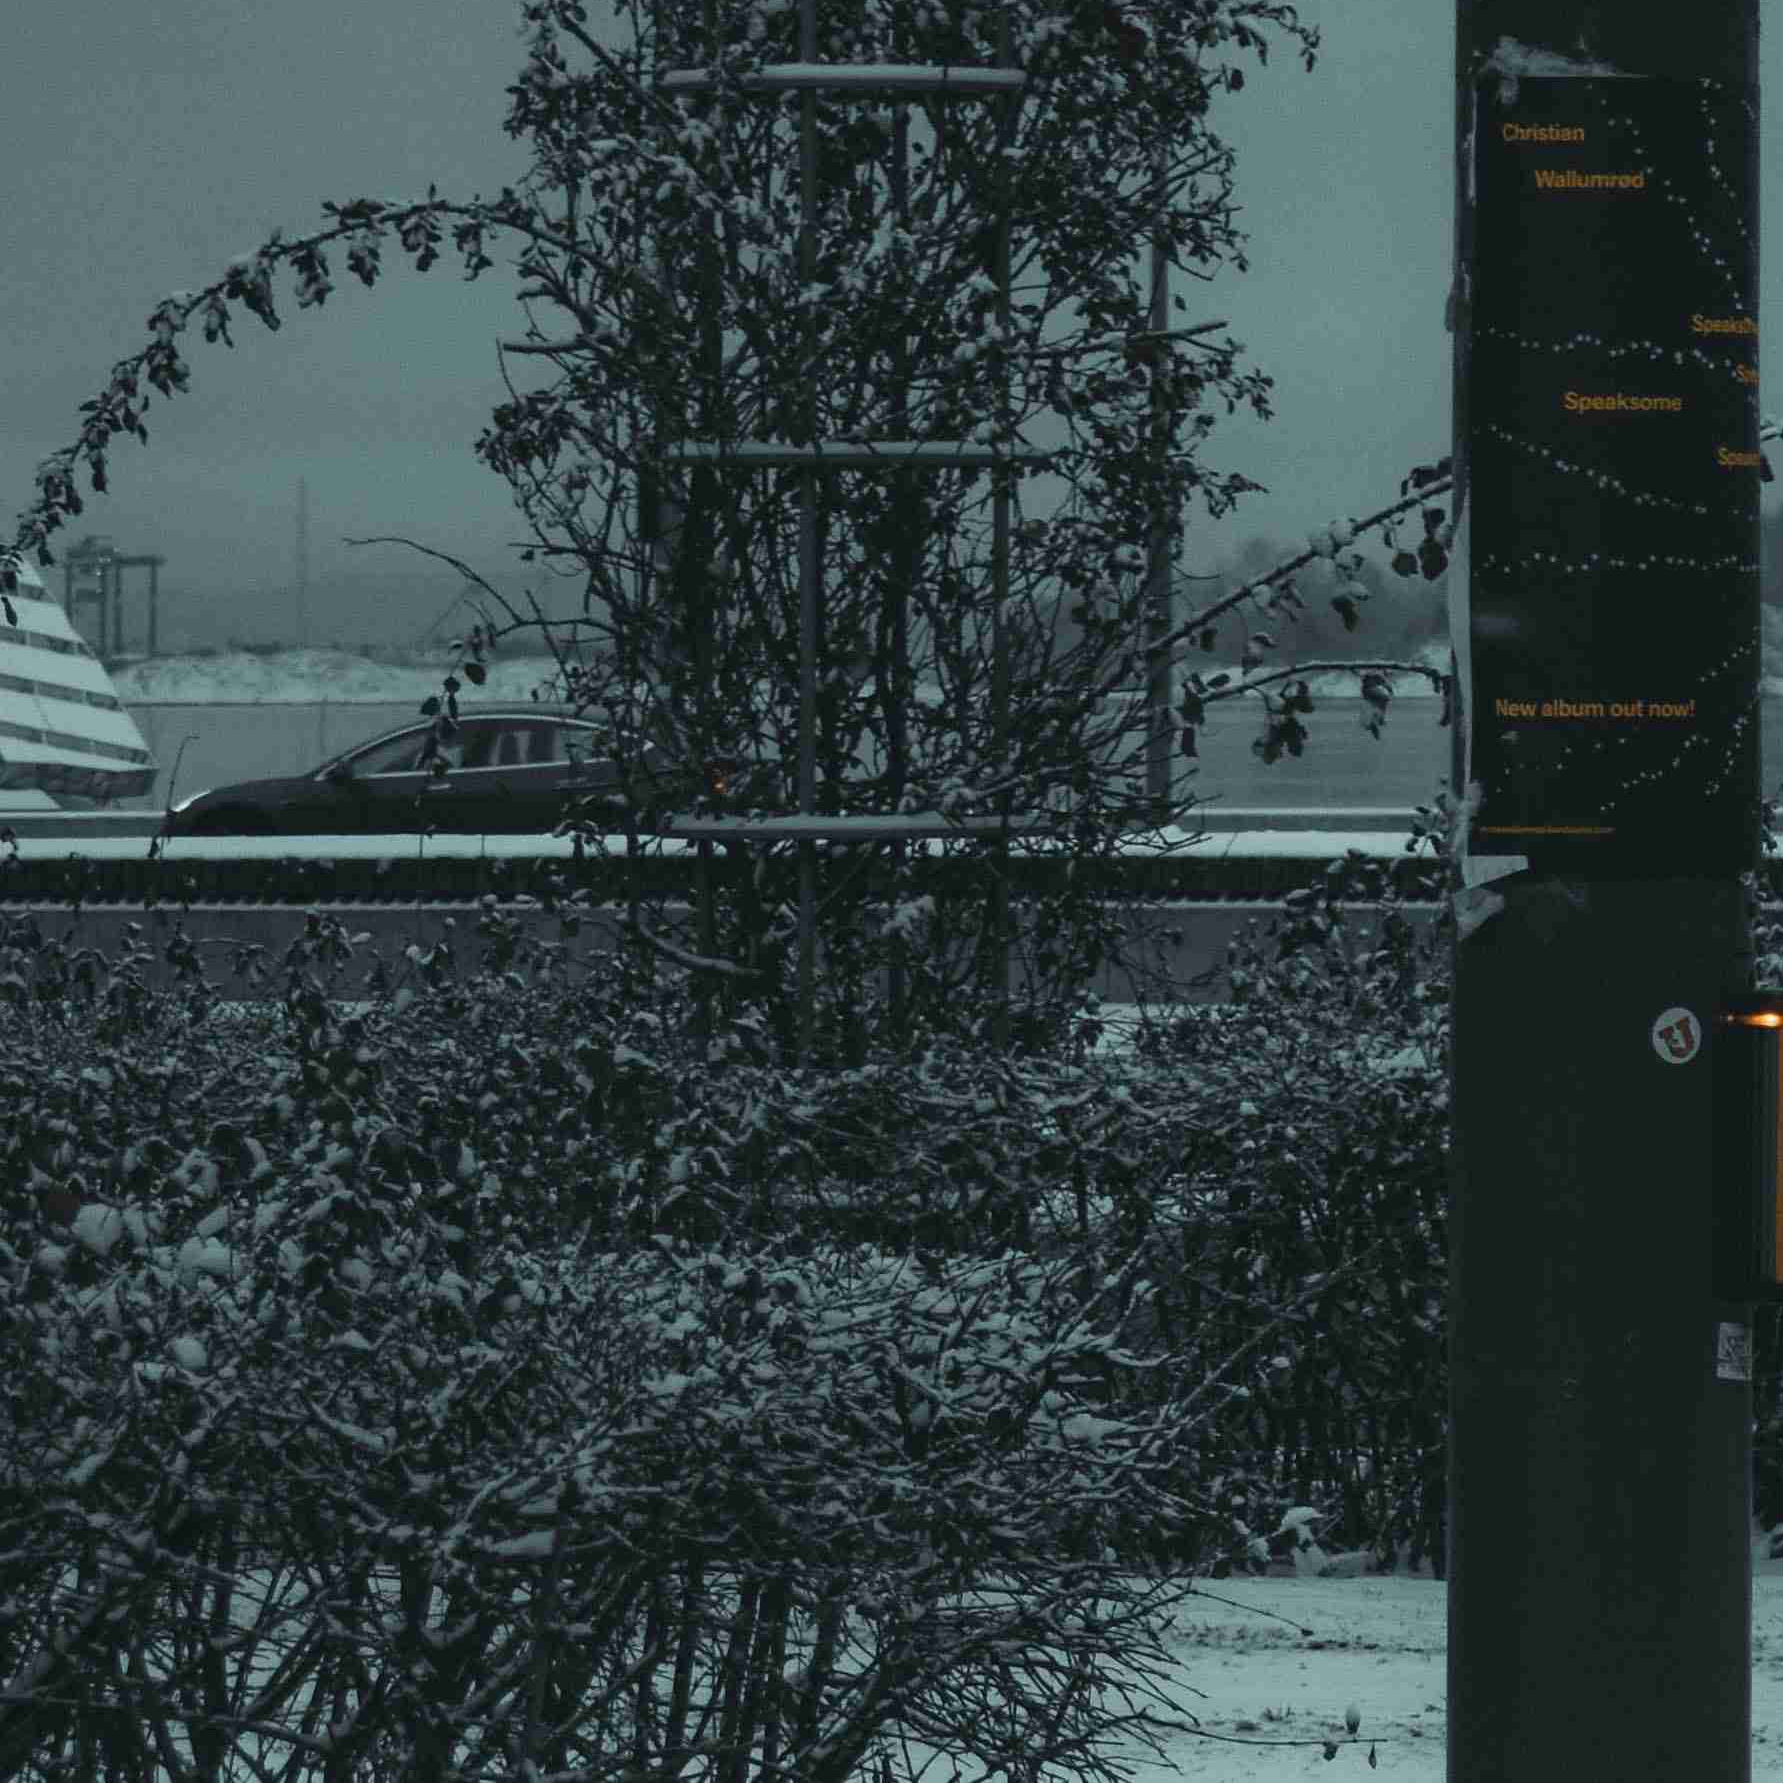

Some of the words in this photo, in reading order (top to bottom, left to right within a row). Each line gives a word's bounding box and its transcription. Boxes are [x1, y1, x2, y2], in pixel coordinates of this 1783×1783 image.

[1503, 122, 1585, 141] Christian
[1564, 391, 1682, 415] Speaksome
[1496, 698, 1536, 716] New
[1541, 698, 1605, 716] album
[1610, 700, 1643, 716] out
[1648, 699, 1696, 716] now!
